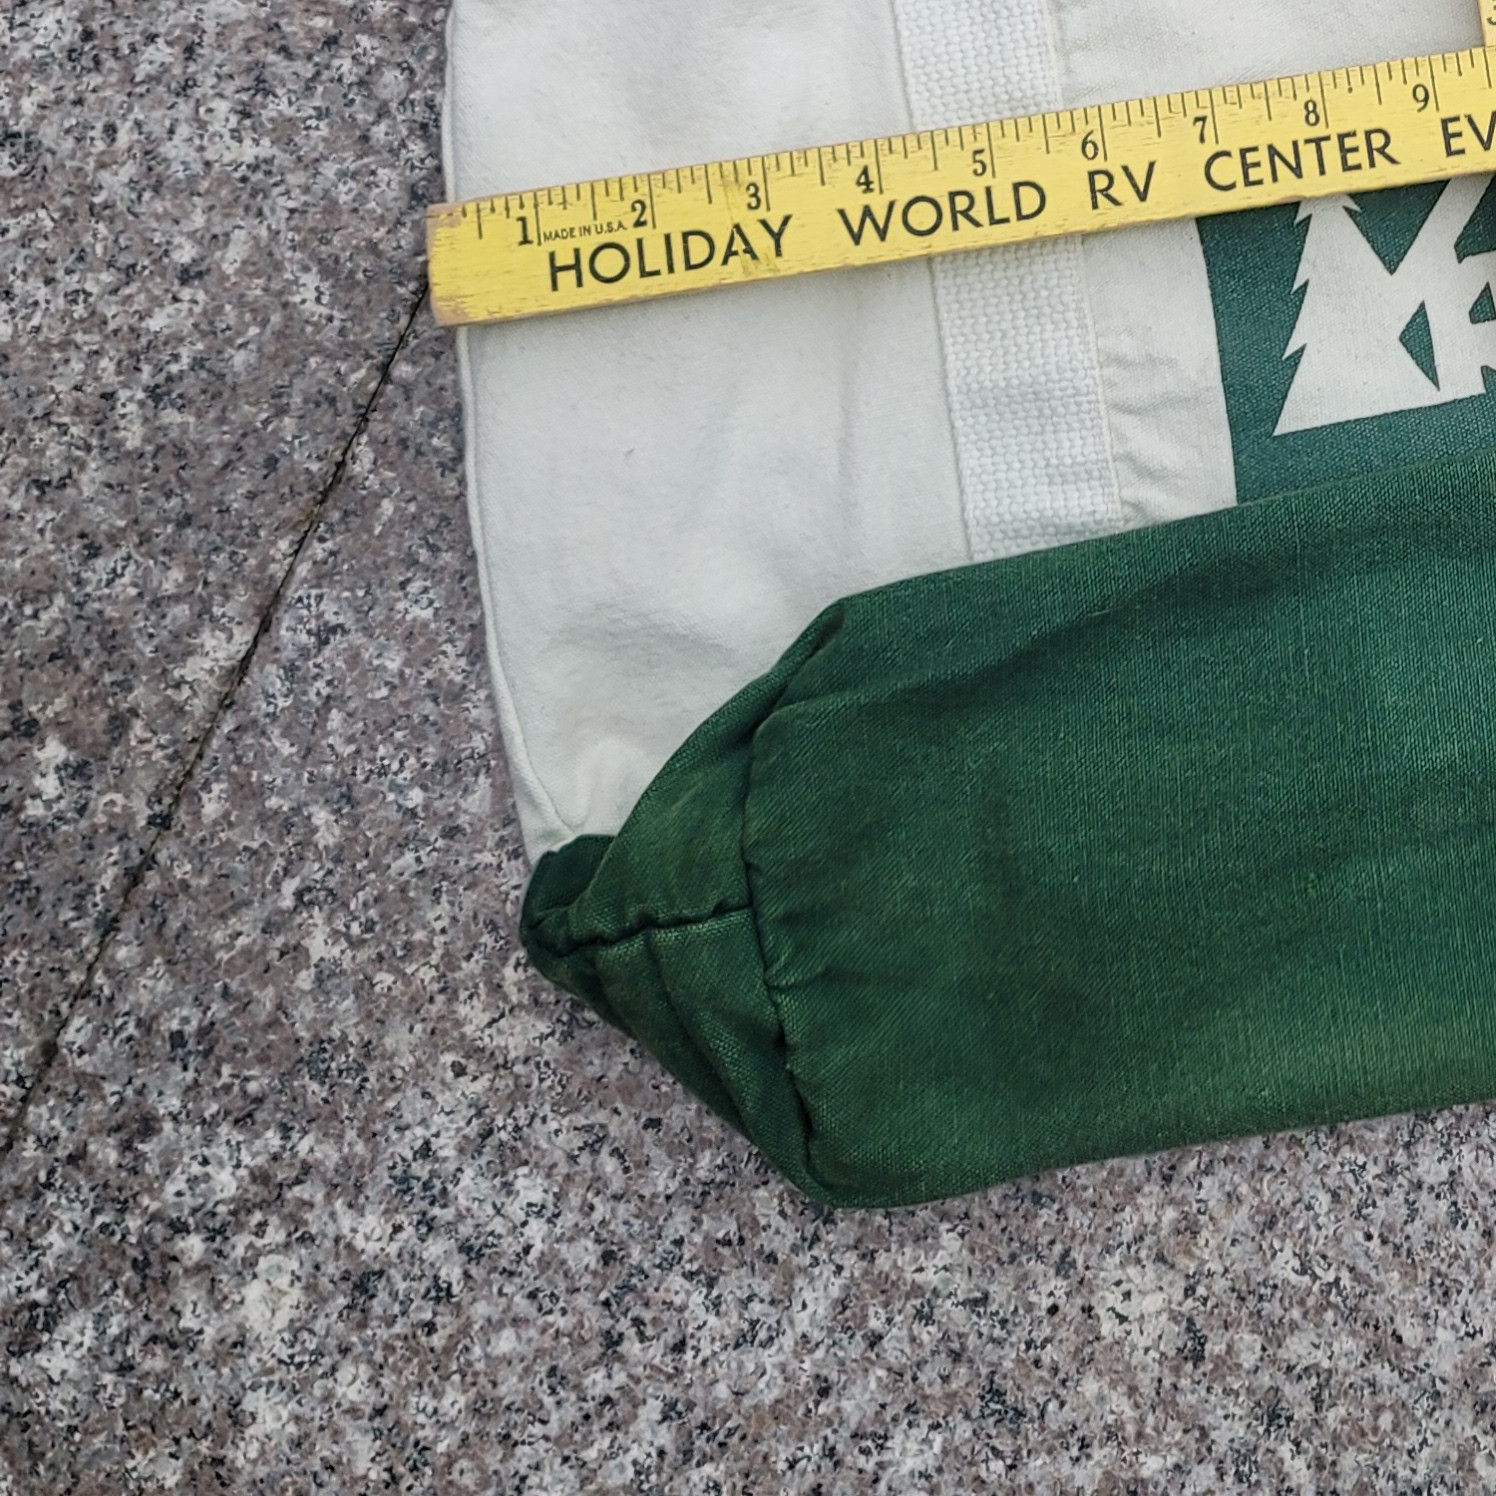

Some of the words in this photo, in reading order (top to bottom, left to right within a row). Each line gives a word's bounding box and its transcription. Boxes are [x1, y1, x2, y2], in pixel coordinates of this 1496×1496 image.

[515, 215, 533, 246] 1
[630, 198, 648, 228] 2
[744, 181, 762, 211] 3
[854, 164, 874, 194] 4
[971, 147, 987, 177] 5
[1080, 129, 1099, 161] 6
[1192, 114, 1208, 144] 7
[1302, 98, 1320, 127] 8
[1411, 82, 1430, 112] 9
[542, 226, 576, 242] MADE
[577, 224, 592, 237] IN
[548, 215, 790, 290] HOLIDAY
[838, 180, 1046, 245] WORLD
[1087, 160, 1155, 210] RV
[1203, 127, 1397, 191] CENTER
